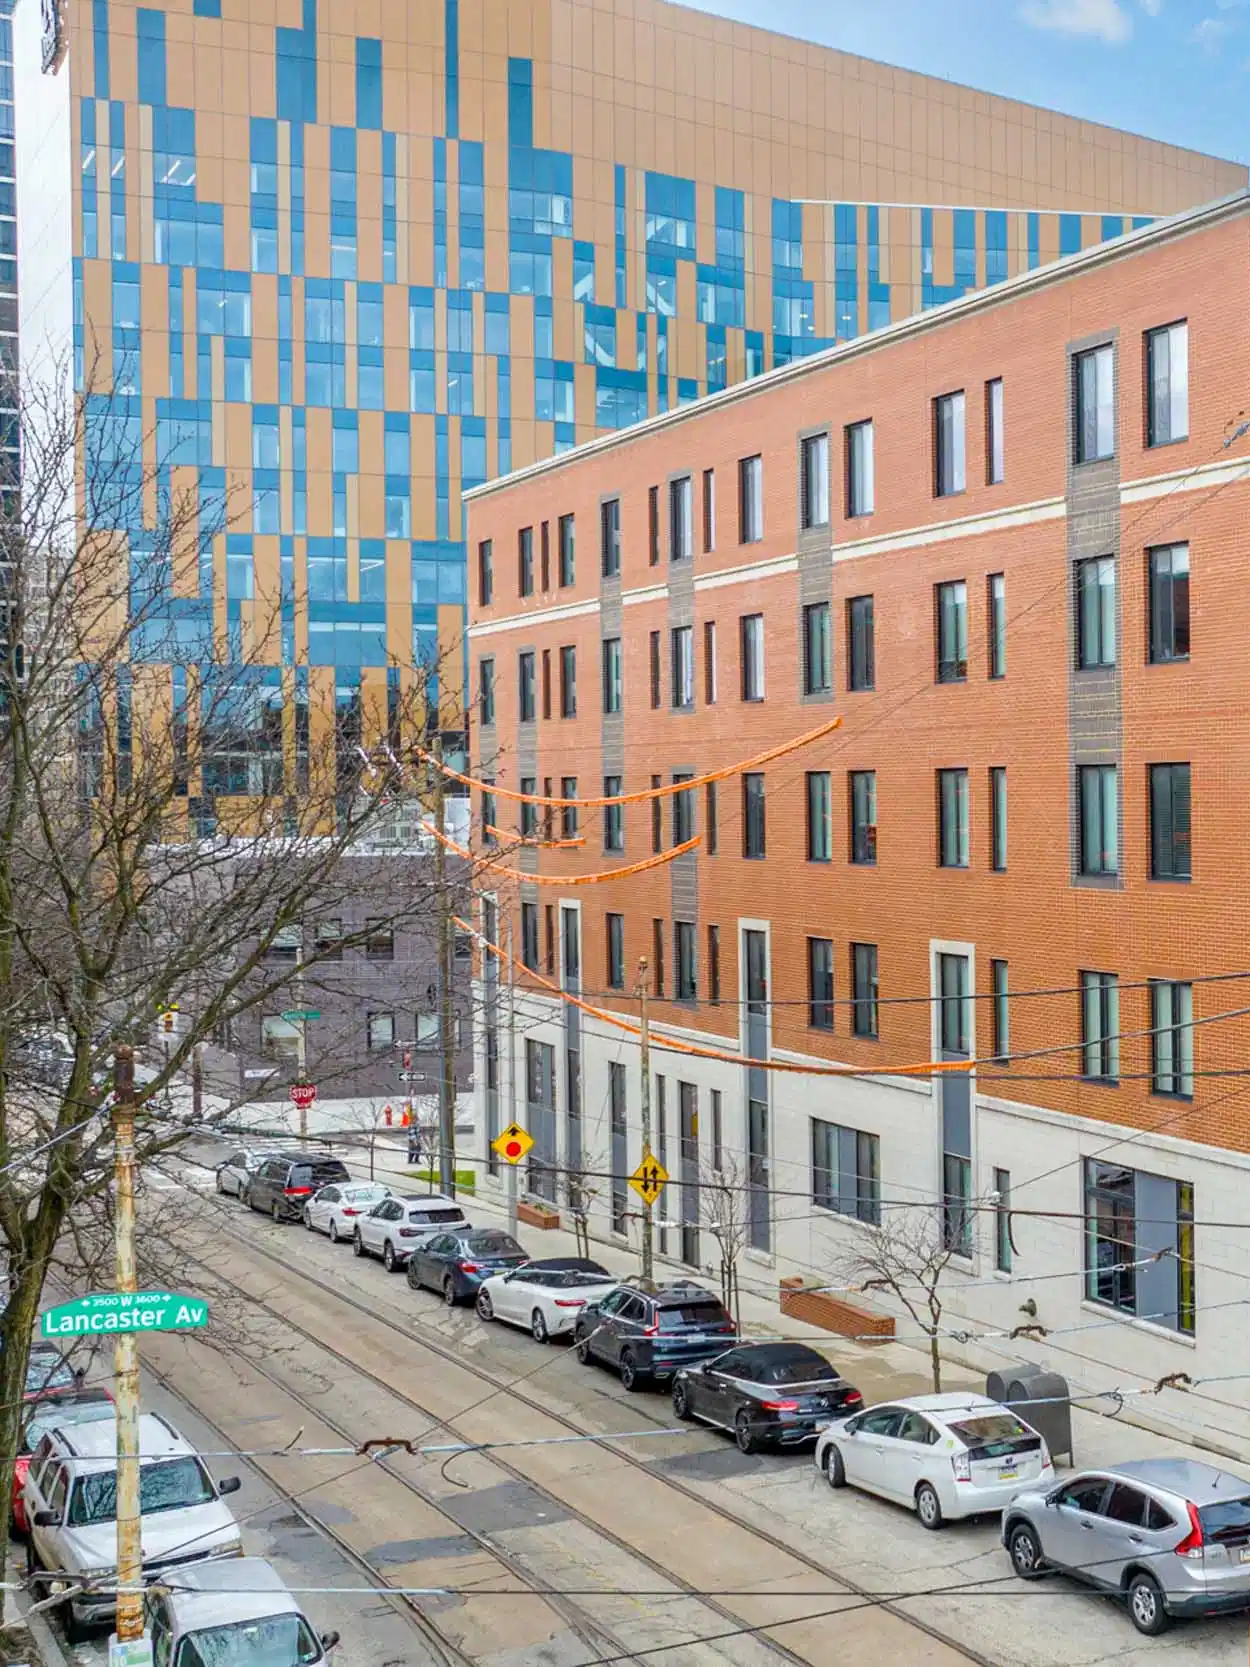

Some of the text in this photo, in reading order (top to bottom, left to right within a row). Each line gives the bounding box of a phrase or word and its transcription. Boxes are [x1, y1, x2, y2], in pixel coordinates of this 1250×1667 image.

[292, 1086, 315, 1098] STOP
[92, 1298, 119, 1308] 3500
[121, 1295, 133, 1308] W
[46, 1304, 204, 1334] Lancaster Av
